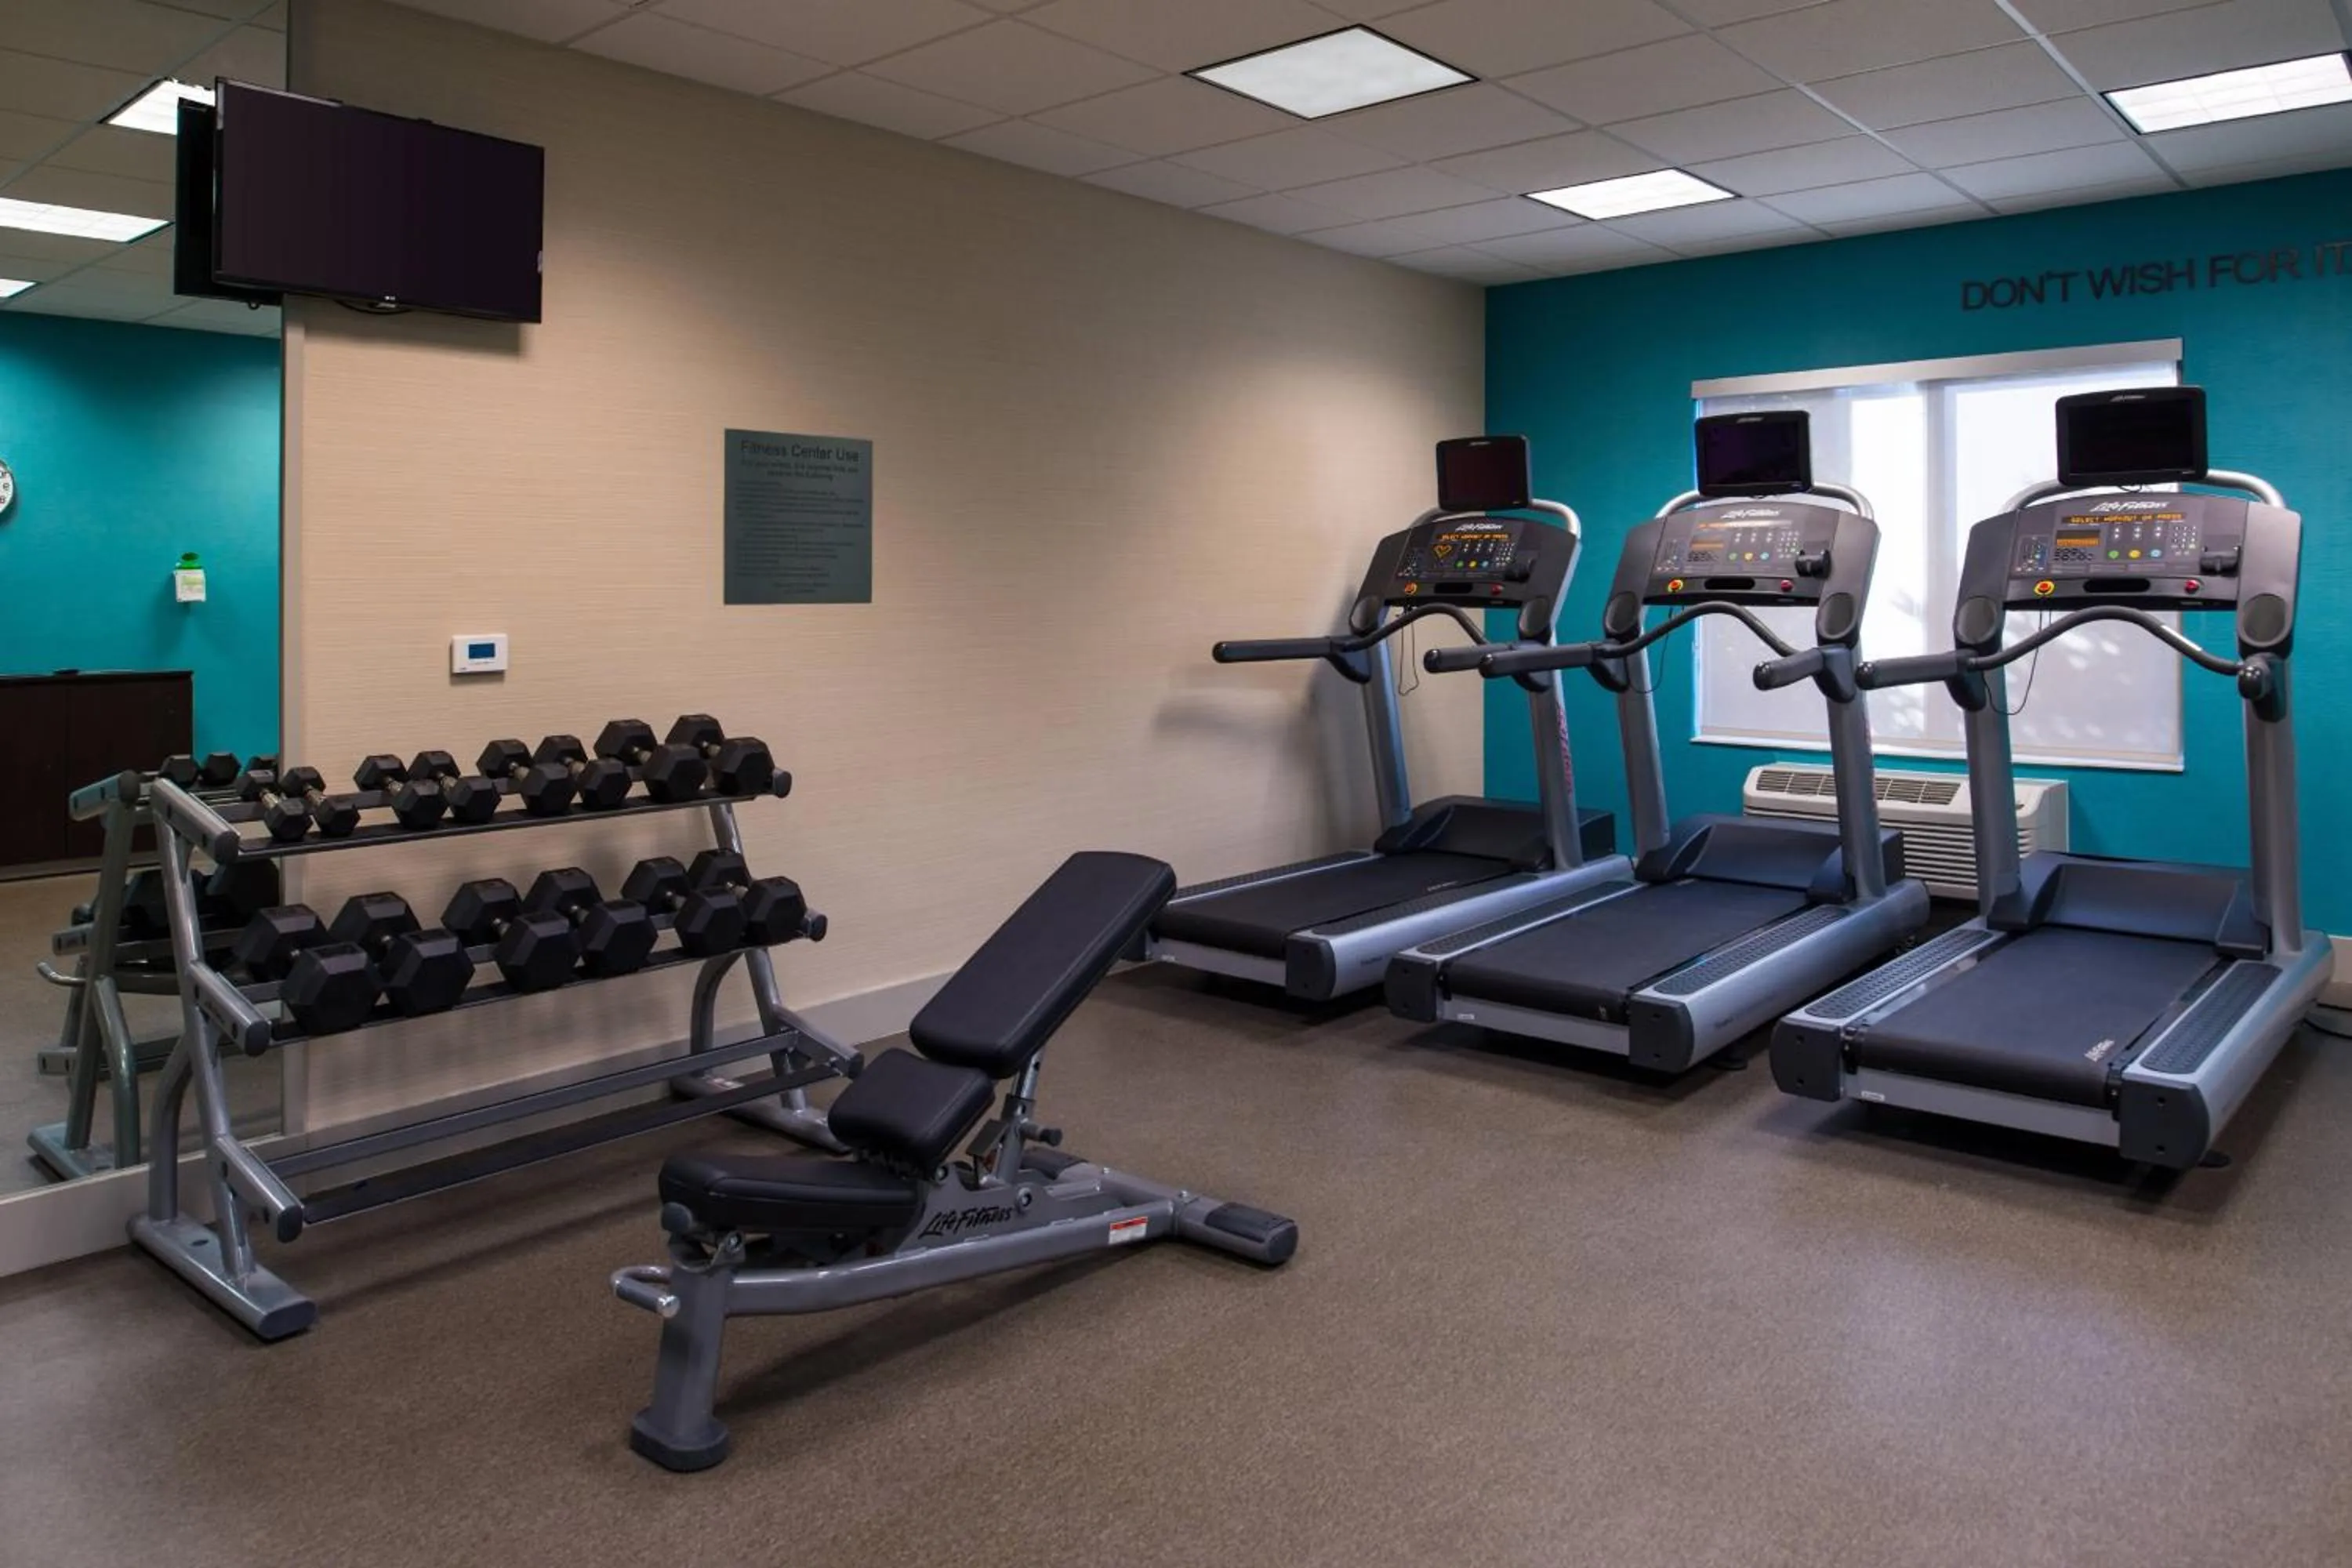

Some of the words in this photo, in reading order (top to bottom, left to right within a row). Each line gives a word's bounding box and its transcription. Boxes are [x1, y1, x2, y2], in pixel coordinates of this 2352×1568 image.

[1962, 270, 2082, 311] DON'T
[2087, 257, 2196, 299] WISH
[2209, 245, 2300, 287] FOR
[791, 444, 831, 460] Center
[836, 449, 859, 463] Use
